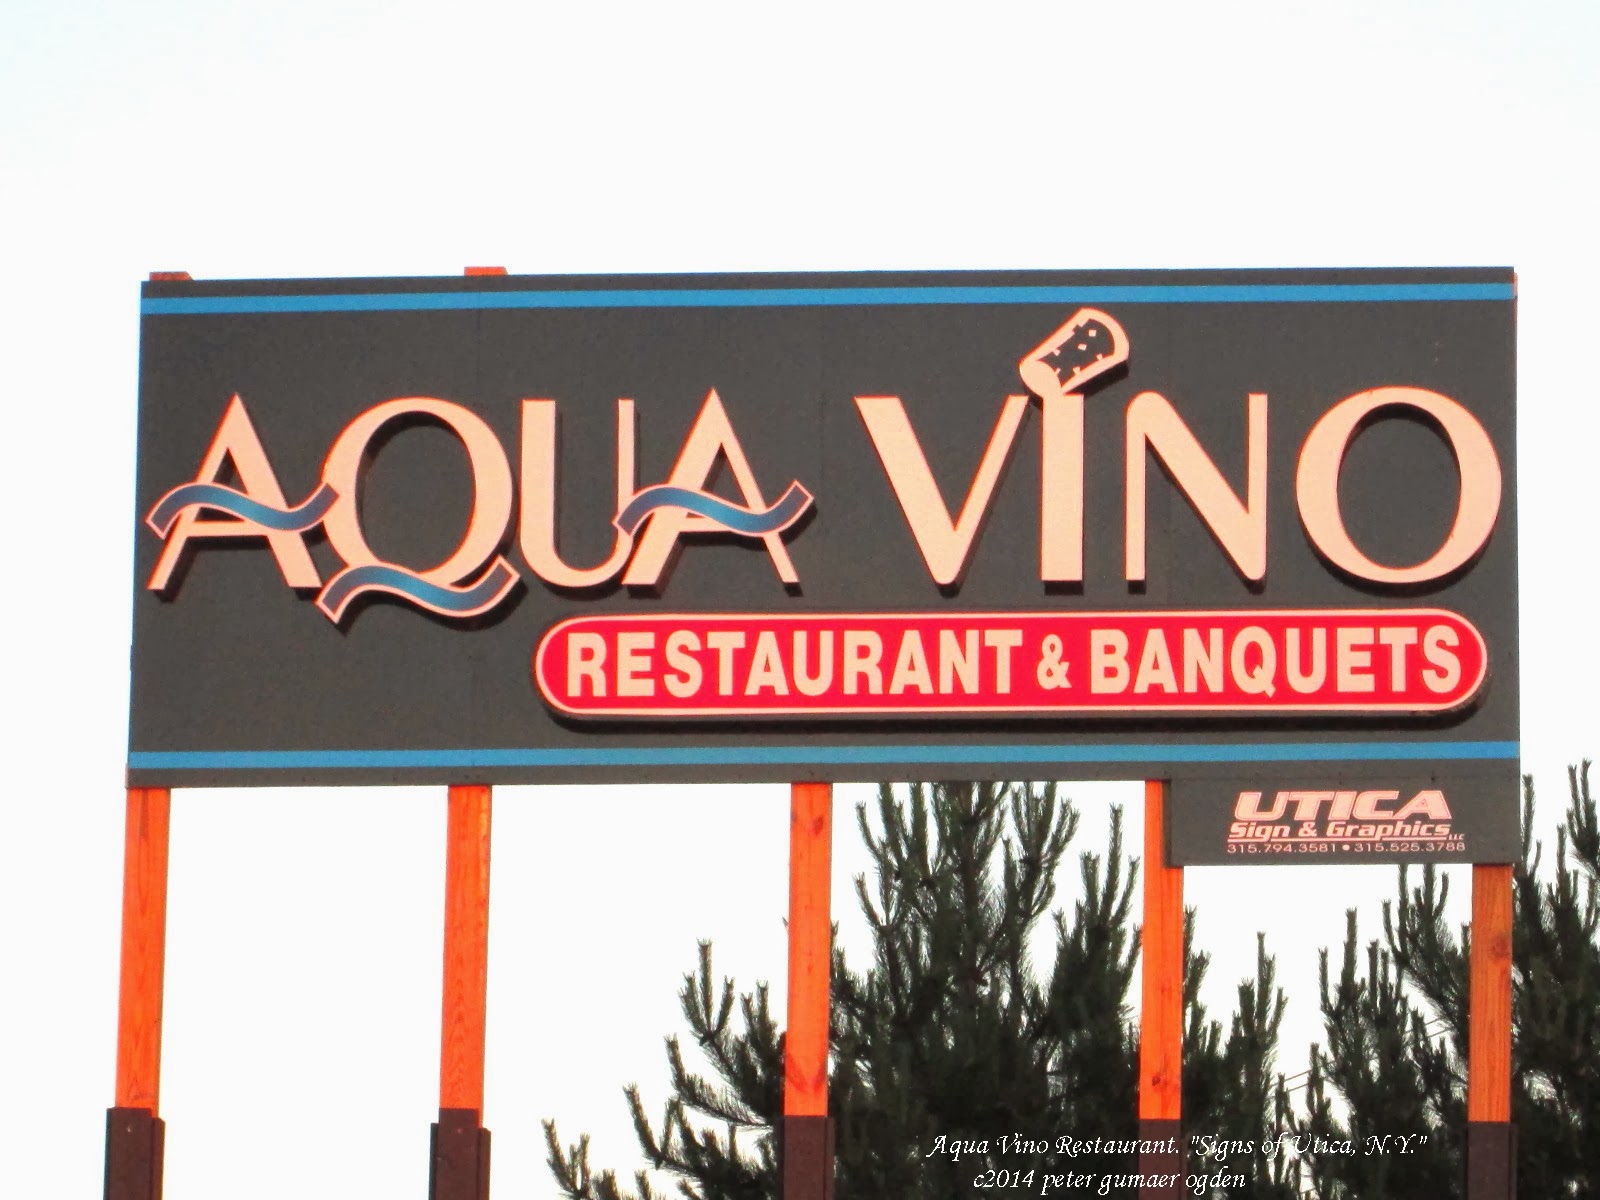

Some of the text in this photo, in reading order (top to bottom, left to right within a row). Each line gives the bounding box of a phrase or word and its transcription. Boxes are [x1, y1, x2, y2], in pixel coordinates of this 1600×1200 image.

[146, 308, 1502, 624] AQUA VINO
[566, 625, 1462, 697] RESTAURANT & BANQUETS
[1234, 790, 1452, 821] UTICA
[1227, 821, 1291, 842] Sign
[1298, 821, 1318, 837] &
[1326, 820, 1451, 841] Graphics
[1227, 842, 1466, 854] 315.794.3581 315.525.3788
